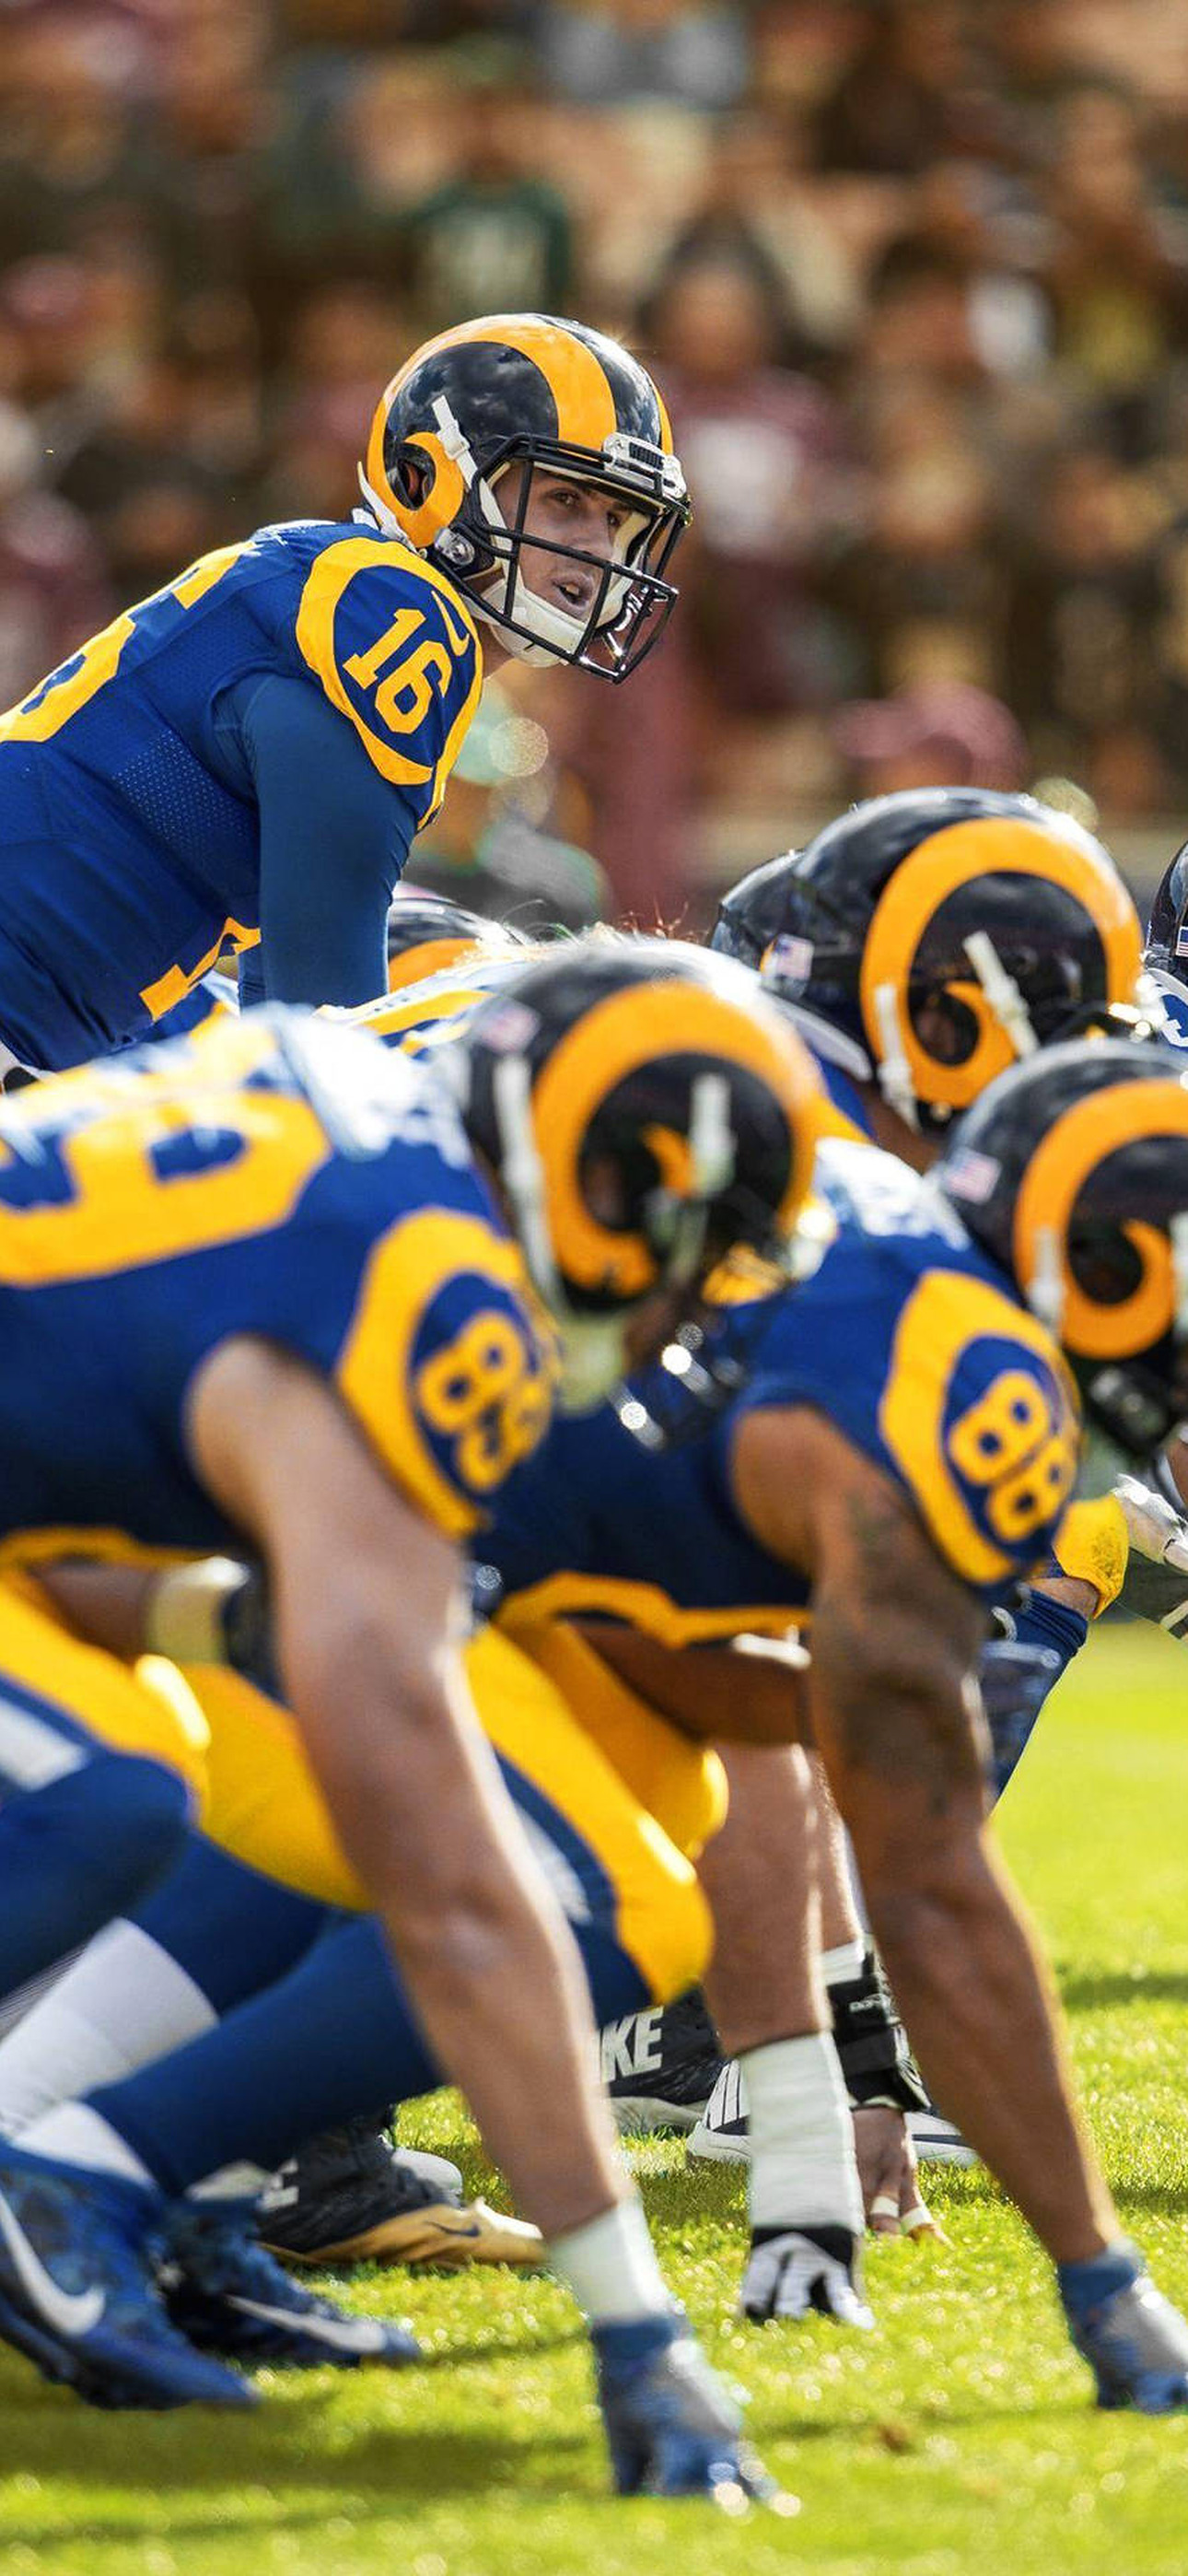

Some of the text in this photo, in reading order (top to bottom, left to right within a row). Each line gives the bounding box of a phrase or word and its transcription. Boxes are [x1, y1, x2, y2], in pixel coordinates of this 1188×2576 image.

[343, 609, 452, 734] 16
[949, 1372, 1077, 1541] 88
[599, 2006, 664, 2083] KE
